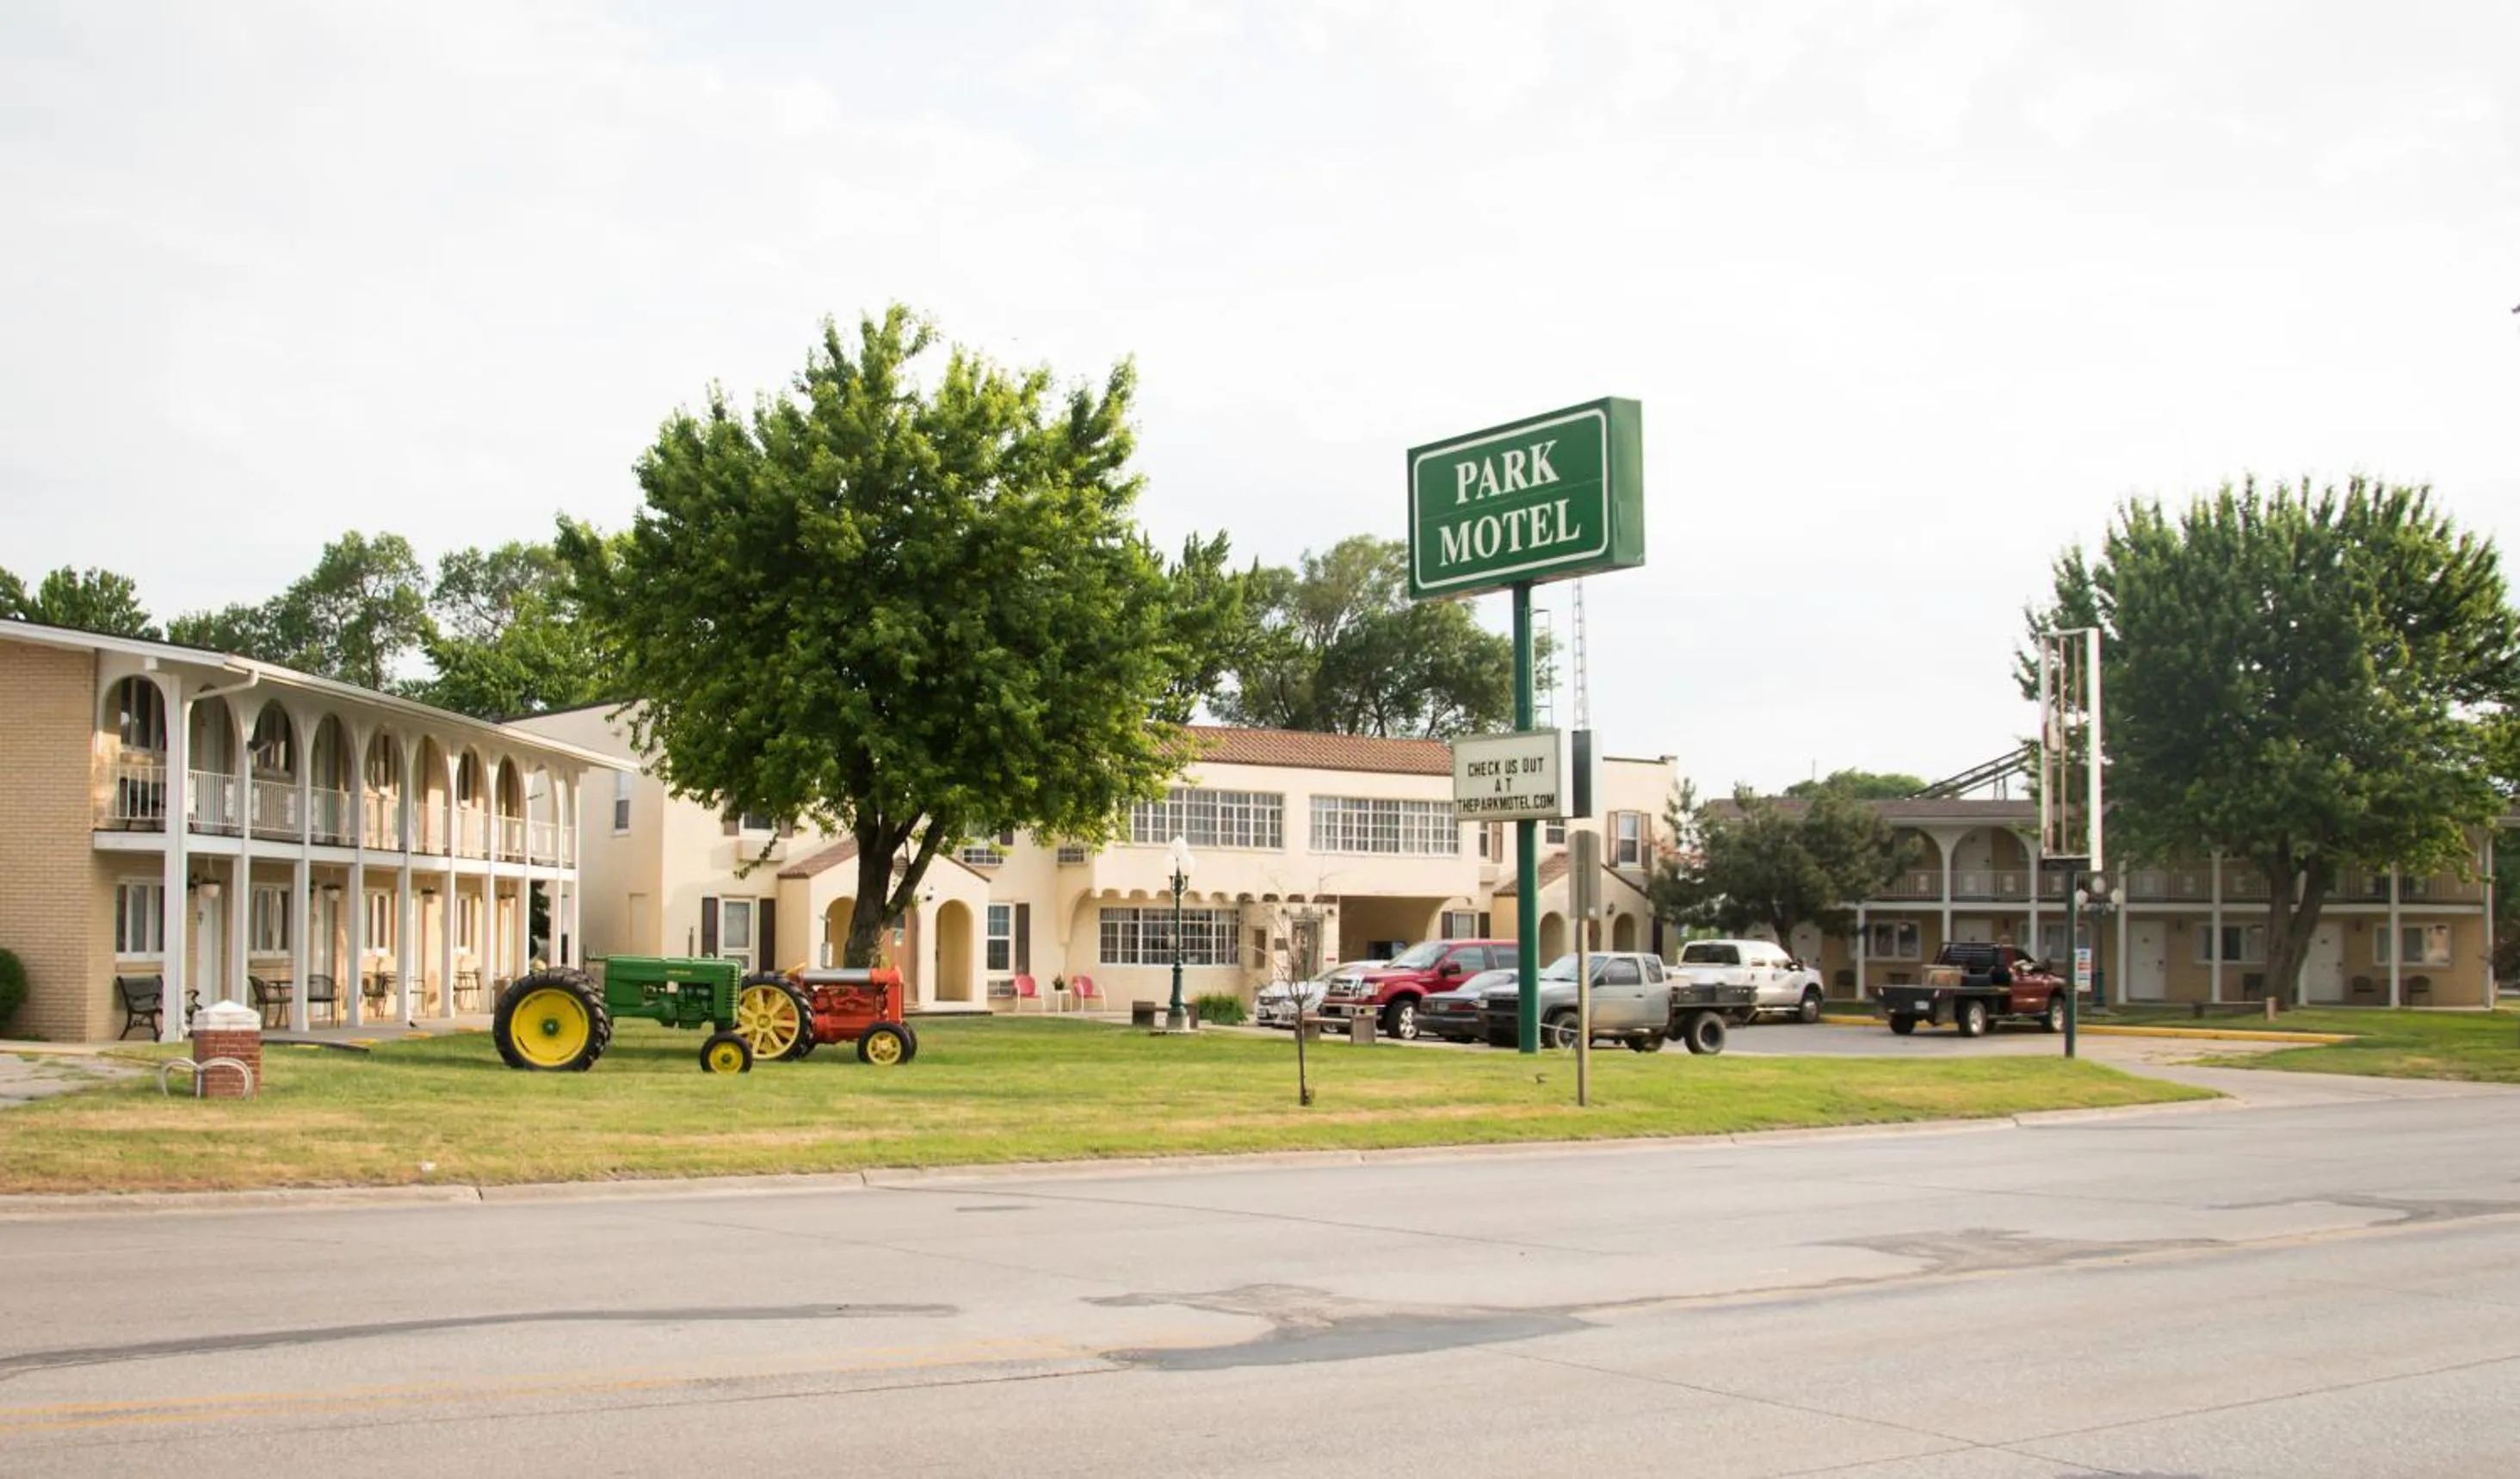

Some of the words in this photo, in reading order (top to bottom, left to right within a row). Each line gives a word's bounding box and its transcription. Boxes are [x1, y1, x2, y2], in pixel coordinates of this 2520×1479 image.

[1455, 440, 1560, 504] PARK
[1439, 499, 1580, 566] MOTEL
[1467, 759, 1500, 777] CHECK
[1505, 759, 1518, 774] US
[1522, 758, 1544, 773] OUT
[1495, 778, 1511, 792] AT
[1457, 794, 1554, 813] THEPARKMOTEL.COM
